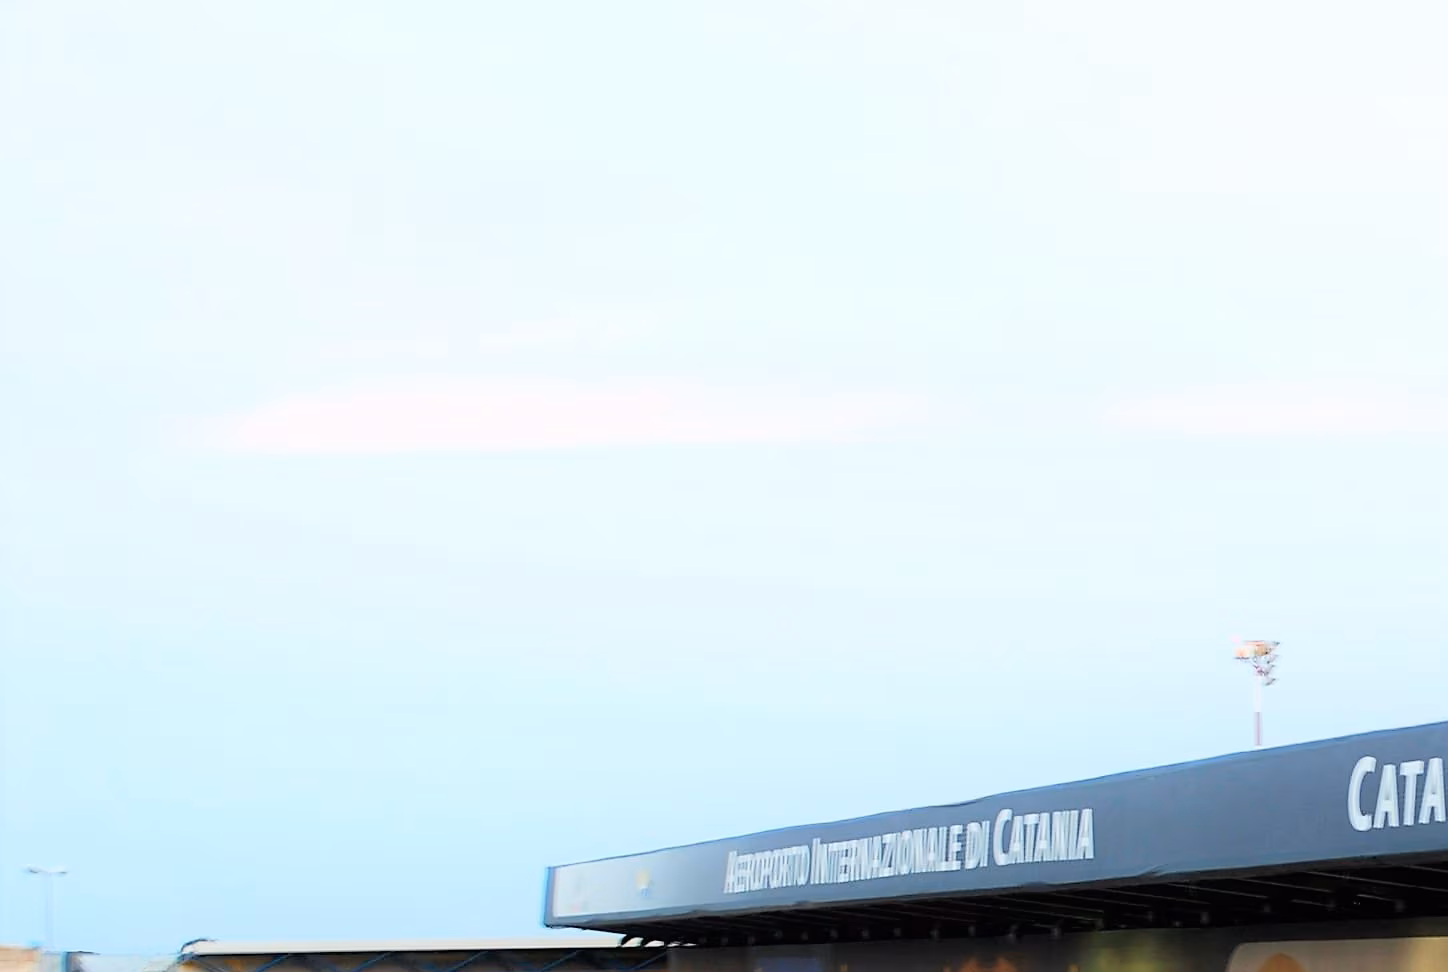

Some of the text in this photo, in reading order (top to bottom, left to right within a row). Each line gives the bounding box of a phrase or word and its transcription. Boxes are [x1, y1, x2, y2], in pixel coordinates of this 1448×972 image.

[723, 808, 1094, 894] AEROPORTO INTERNAZIONALE DI CATANIA
